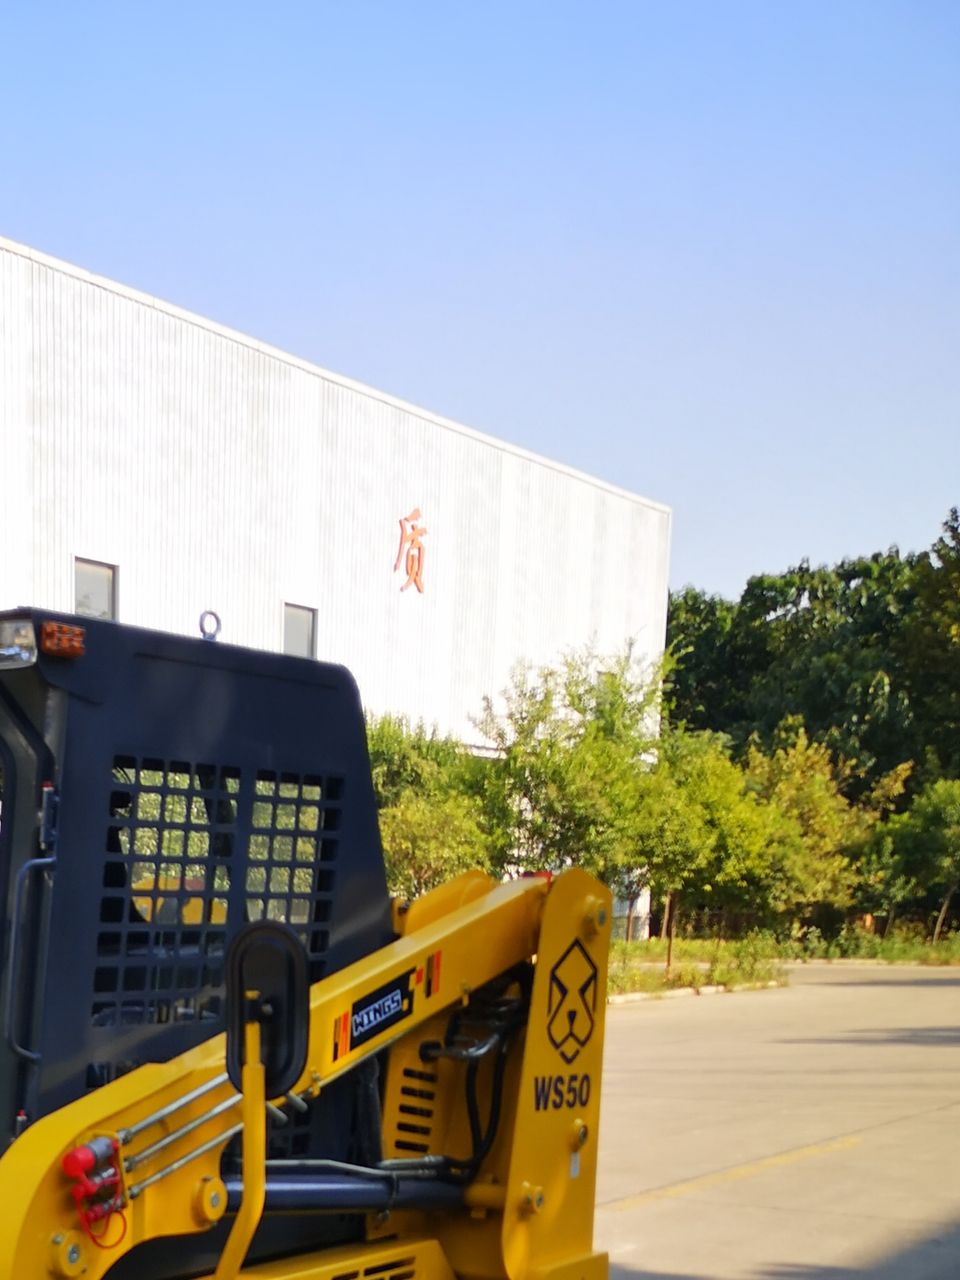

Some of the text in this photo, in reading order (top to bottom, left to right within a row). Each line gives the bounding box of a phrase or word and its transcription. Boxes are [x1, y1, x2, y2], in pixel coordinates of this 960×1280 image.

[394, 507, 427, 593] 质
[351, 988, 402, 1037] WINGS
[534, 1073, 591, 1112] WS50
